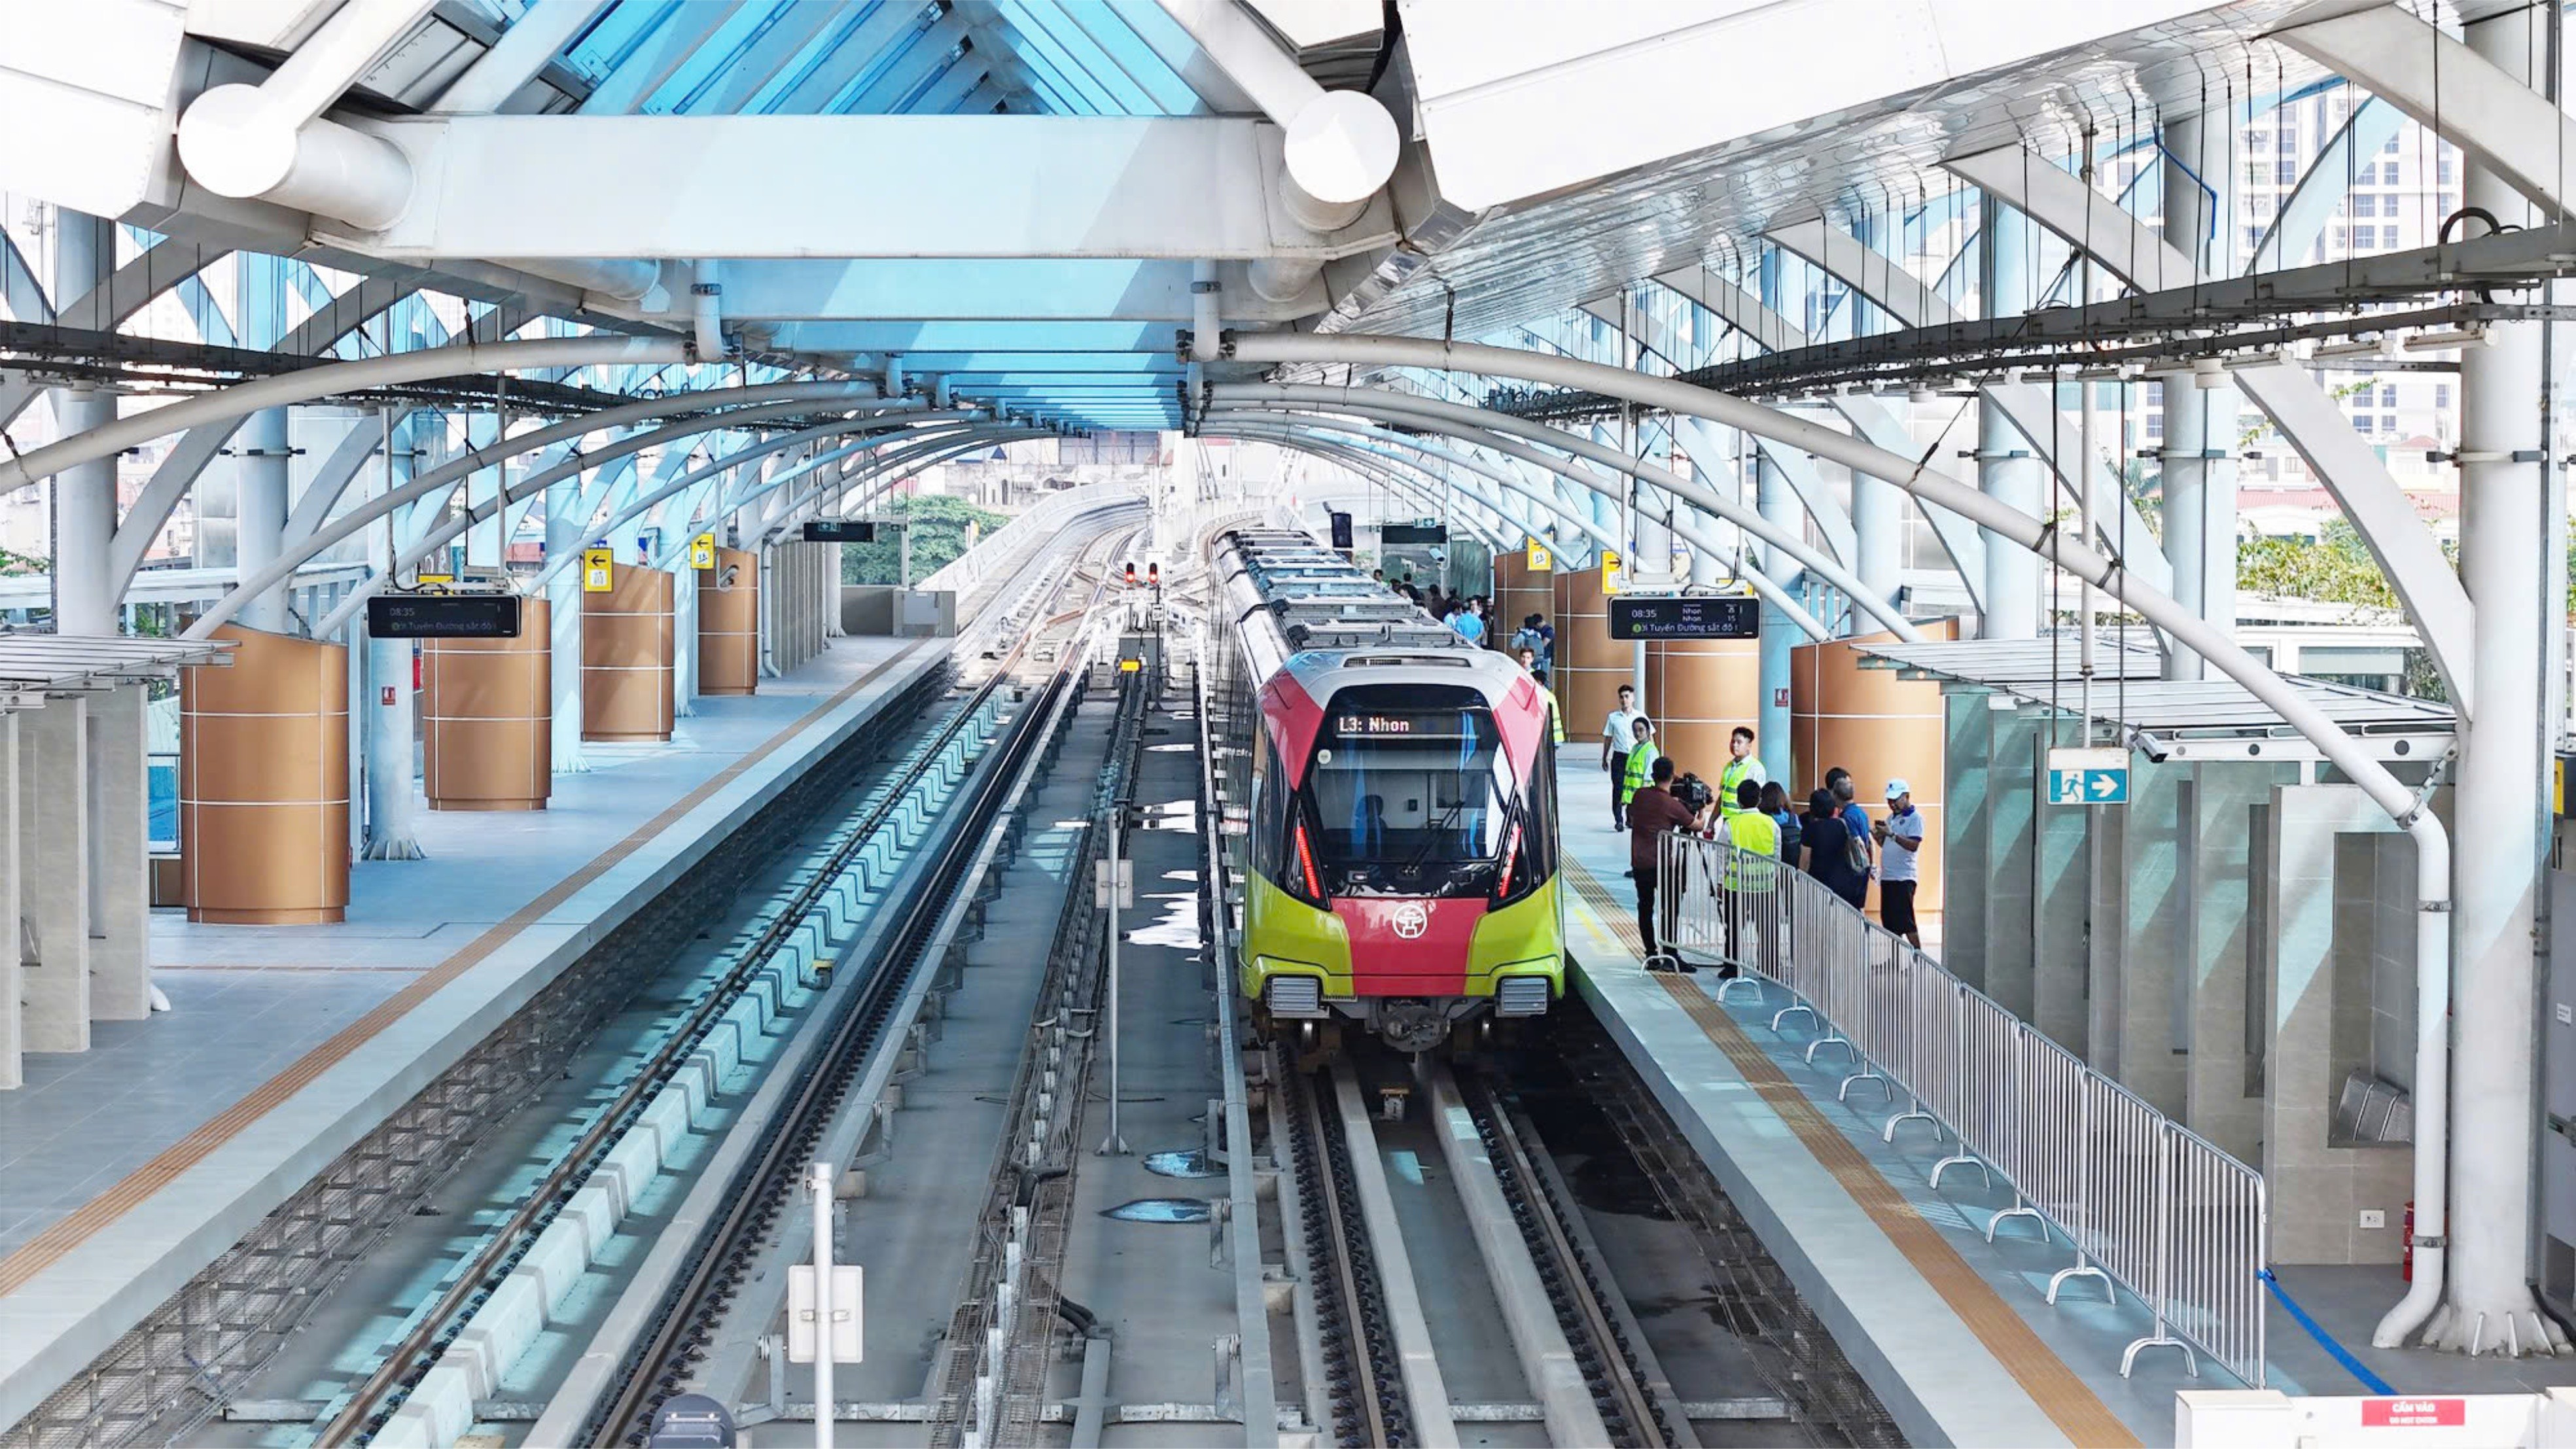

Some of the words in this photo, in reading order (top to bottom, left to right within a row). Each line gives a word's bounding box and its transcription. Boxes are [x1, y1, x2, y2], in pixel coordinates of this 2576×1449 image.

[389, 608, 415, 617] 08:35
[1631, 609, 1657, 618] 08:35
[1339, 716, 1362, 732] L3:
[1368, 716, 1409, 732] Nhon
